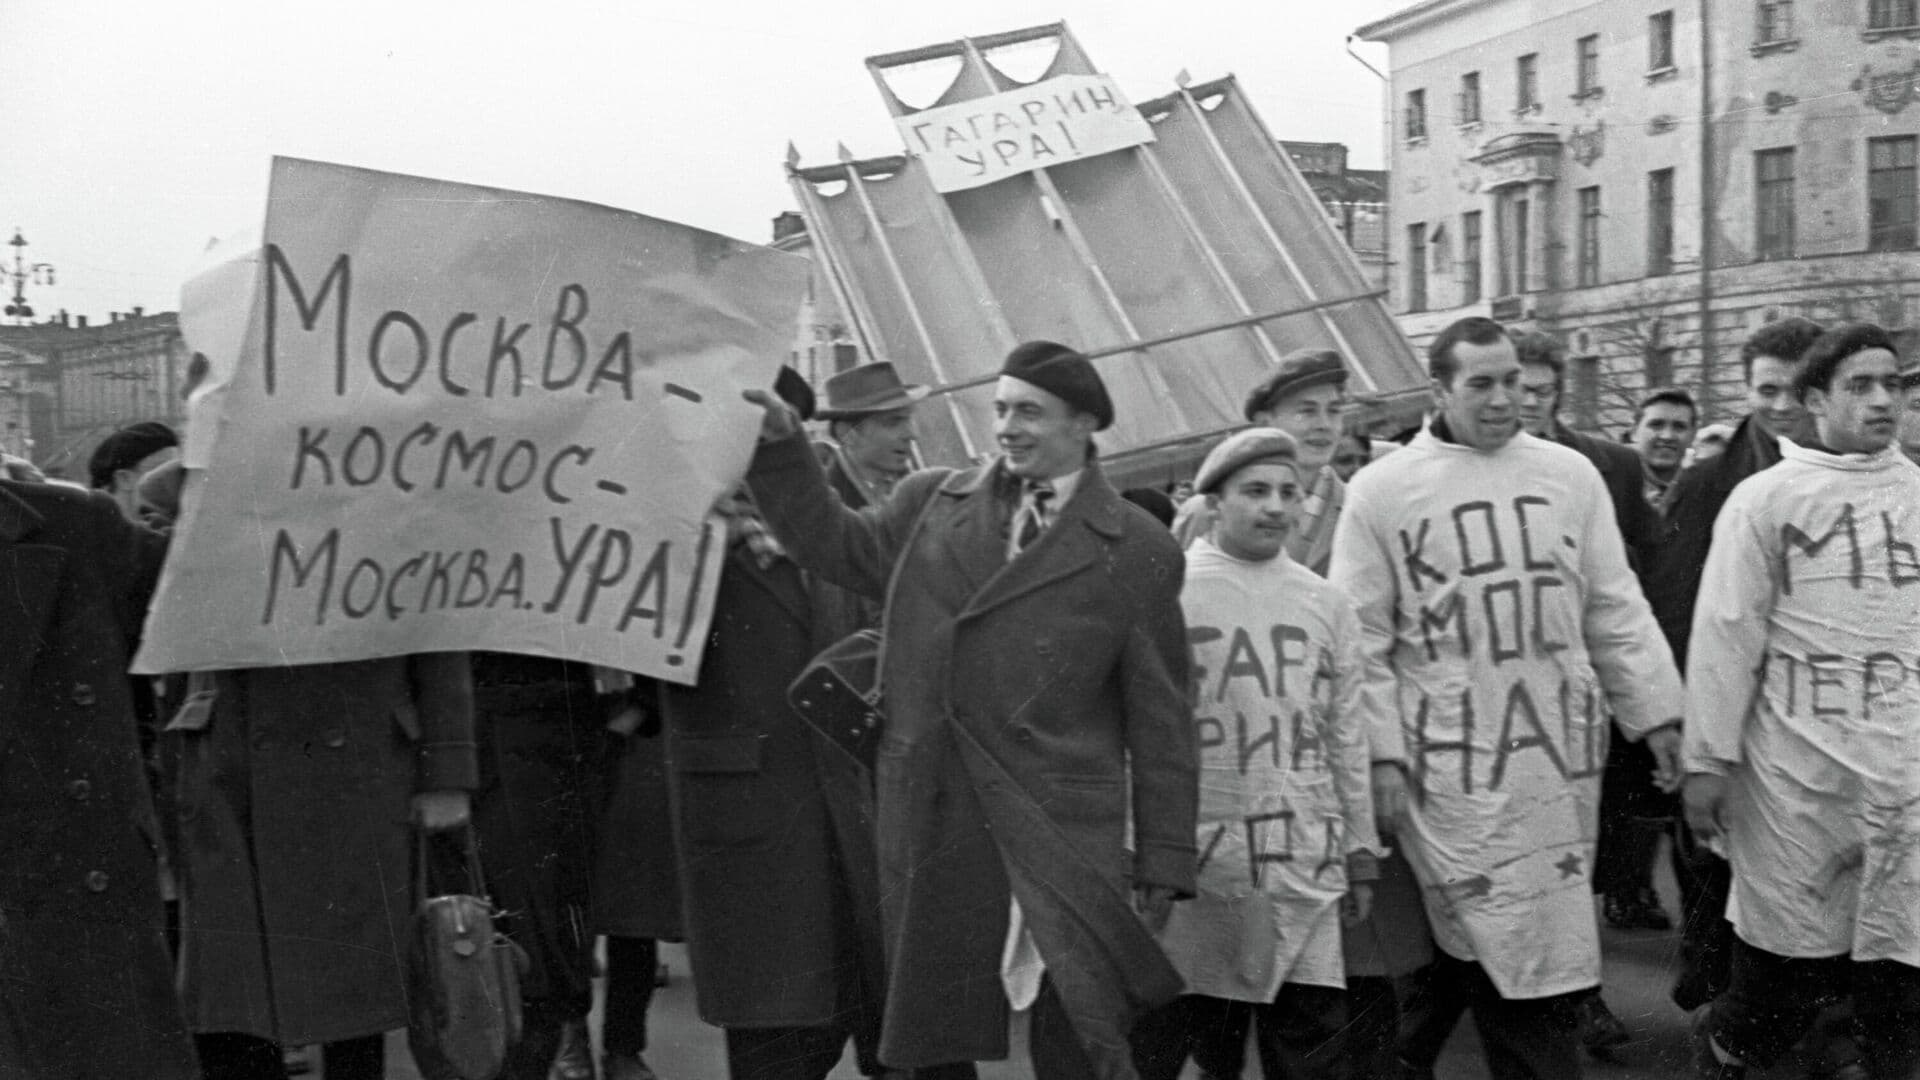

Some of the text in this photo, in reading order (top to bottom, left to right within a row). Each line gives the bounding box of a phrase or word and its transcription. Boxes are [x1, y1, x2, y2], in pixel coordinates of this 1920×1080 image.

[956, 120, 1081, 176] УРА!
[542, 516, 713, 667] УРА!
[1420, 575, 1568, 665] МОС
